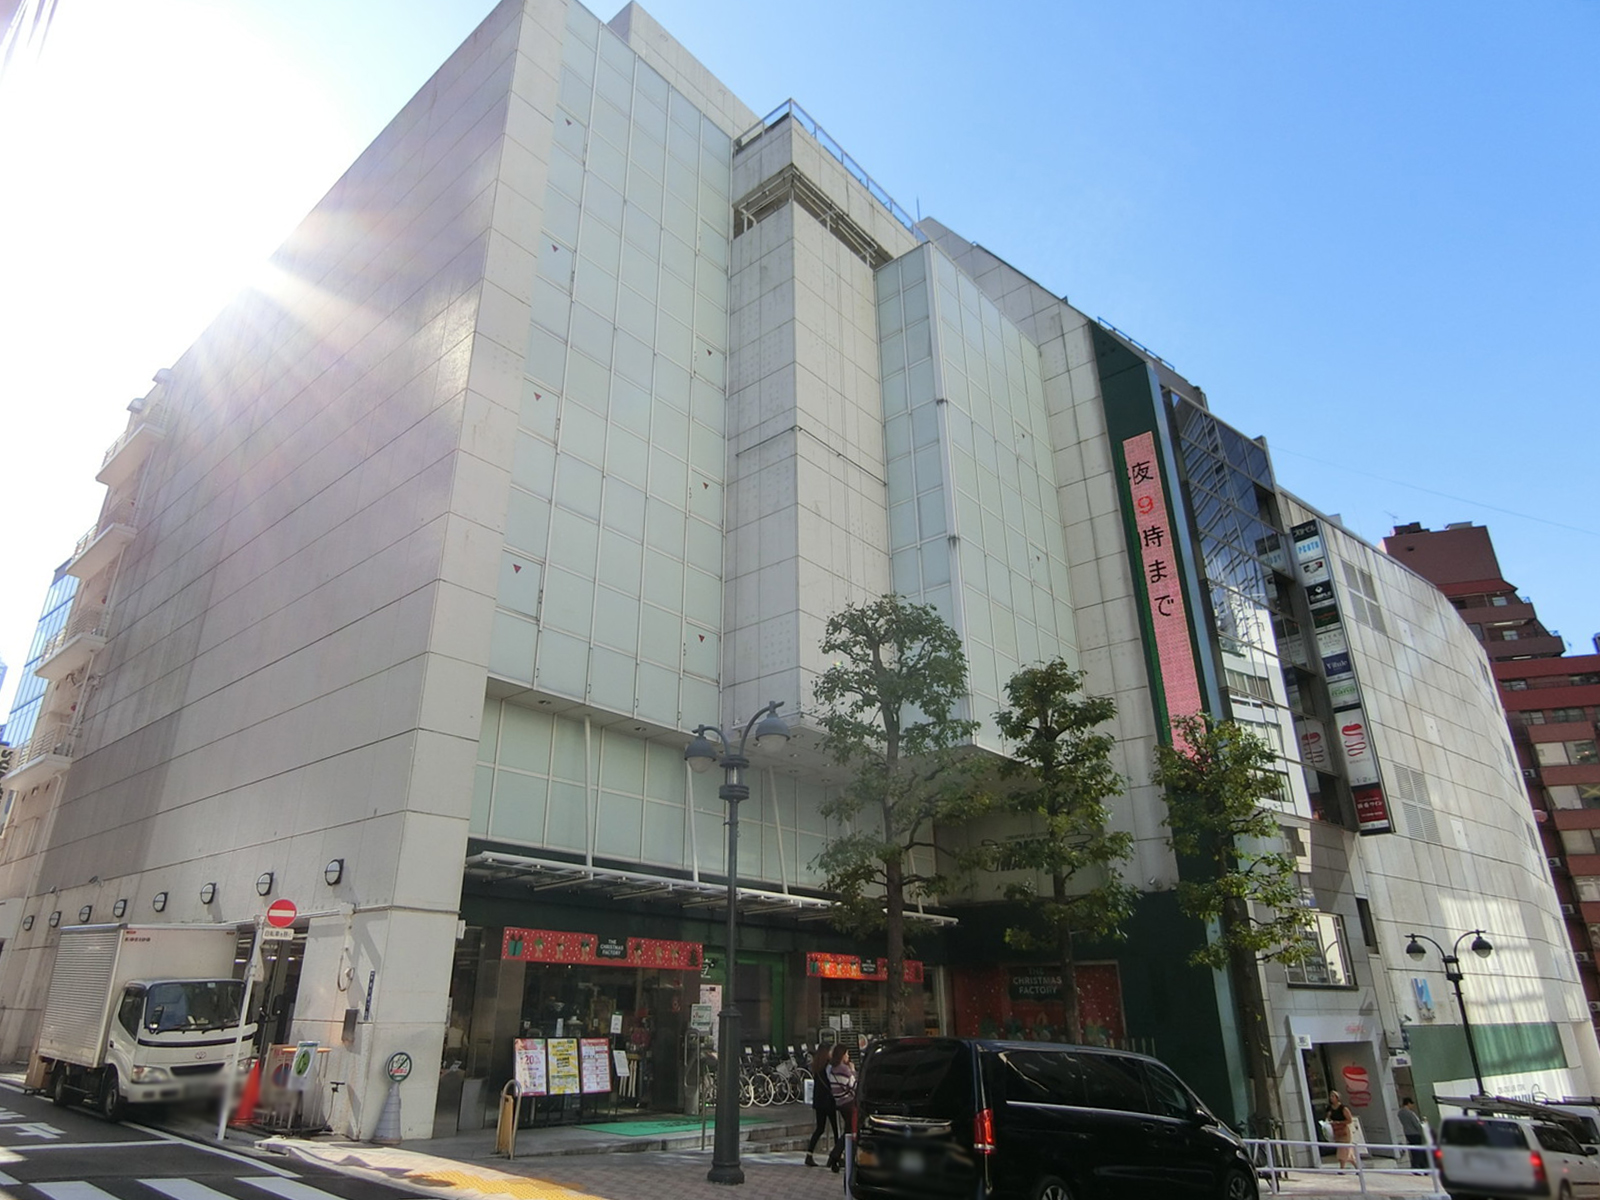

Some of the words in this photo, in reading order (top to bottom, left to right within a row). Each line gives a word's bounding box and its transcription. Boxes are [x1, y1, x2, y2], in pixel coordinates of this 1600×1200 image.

[1028, 967, 1045, 975] THE
[1013, 976, 1062, 985] CHRISTMAS
[1019, 985, 1058, 995] FACTORY
